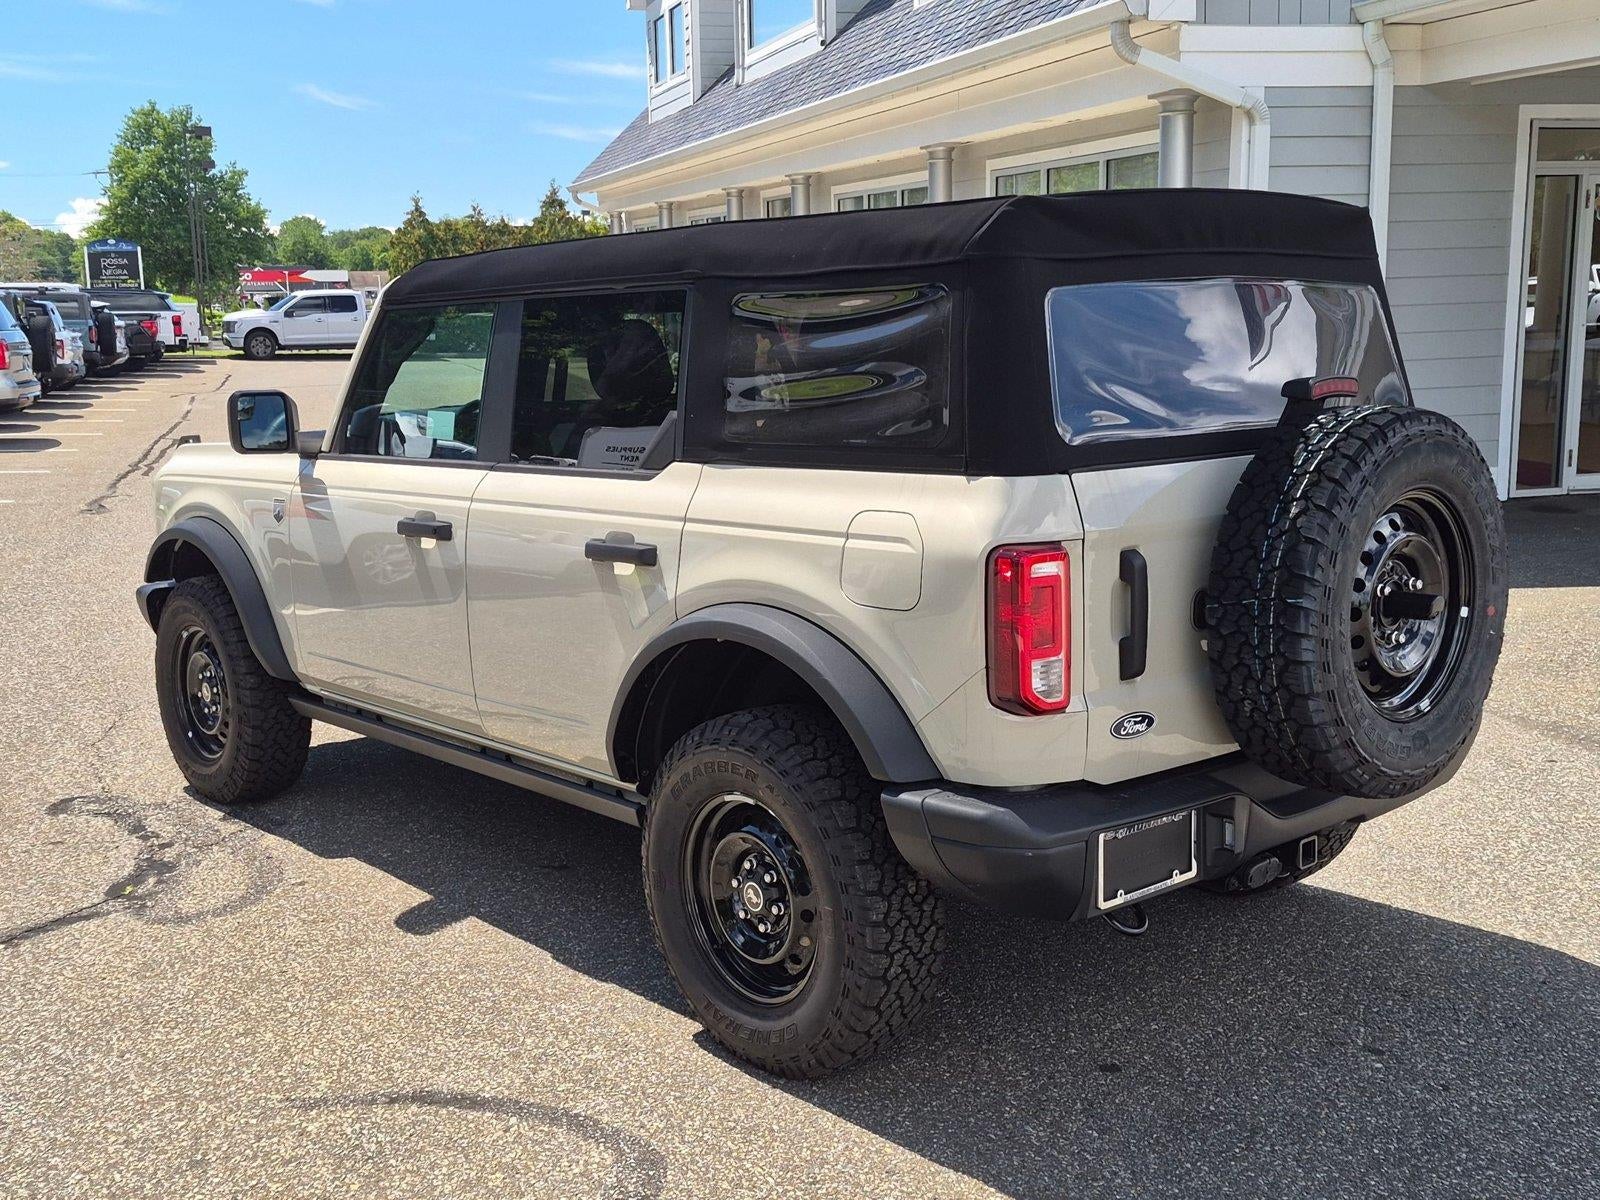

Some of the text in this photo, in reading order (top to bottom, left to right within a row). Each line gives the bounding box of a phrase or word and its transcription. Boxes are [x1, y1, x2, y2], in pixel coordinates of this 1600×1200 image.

[101, 258, 128, 268] ROSSA
[1120, 717, 1148, 735] Ford
[670, 759, 760, 800] GRABBER
[702, 992, 800, 1046] GENERAL
